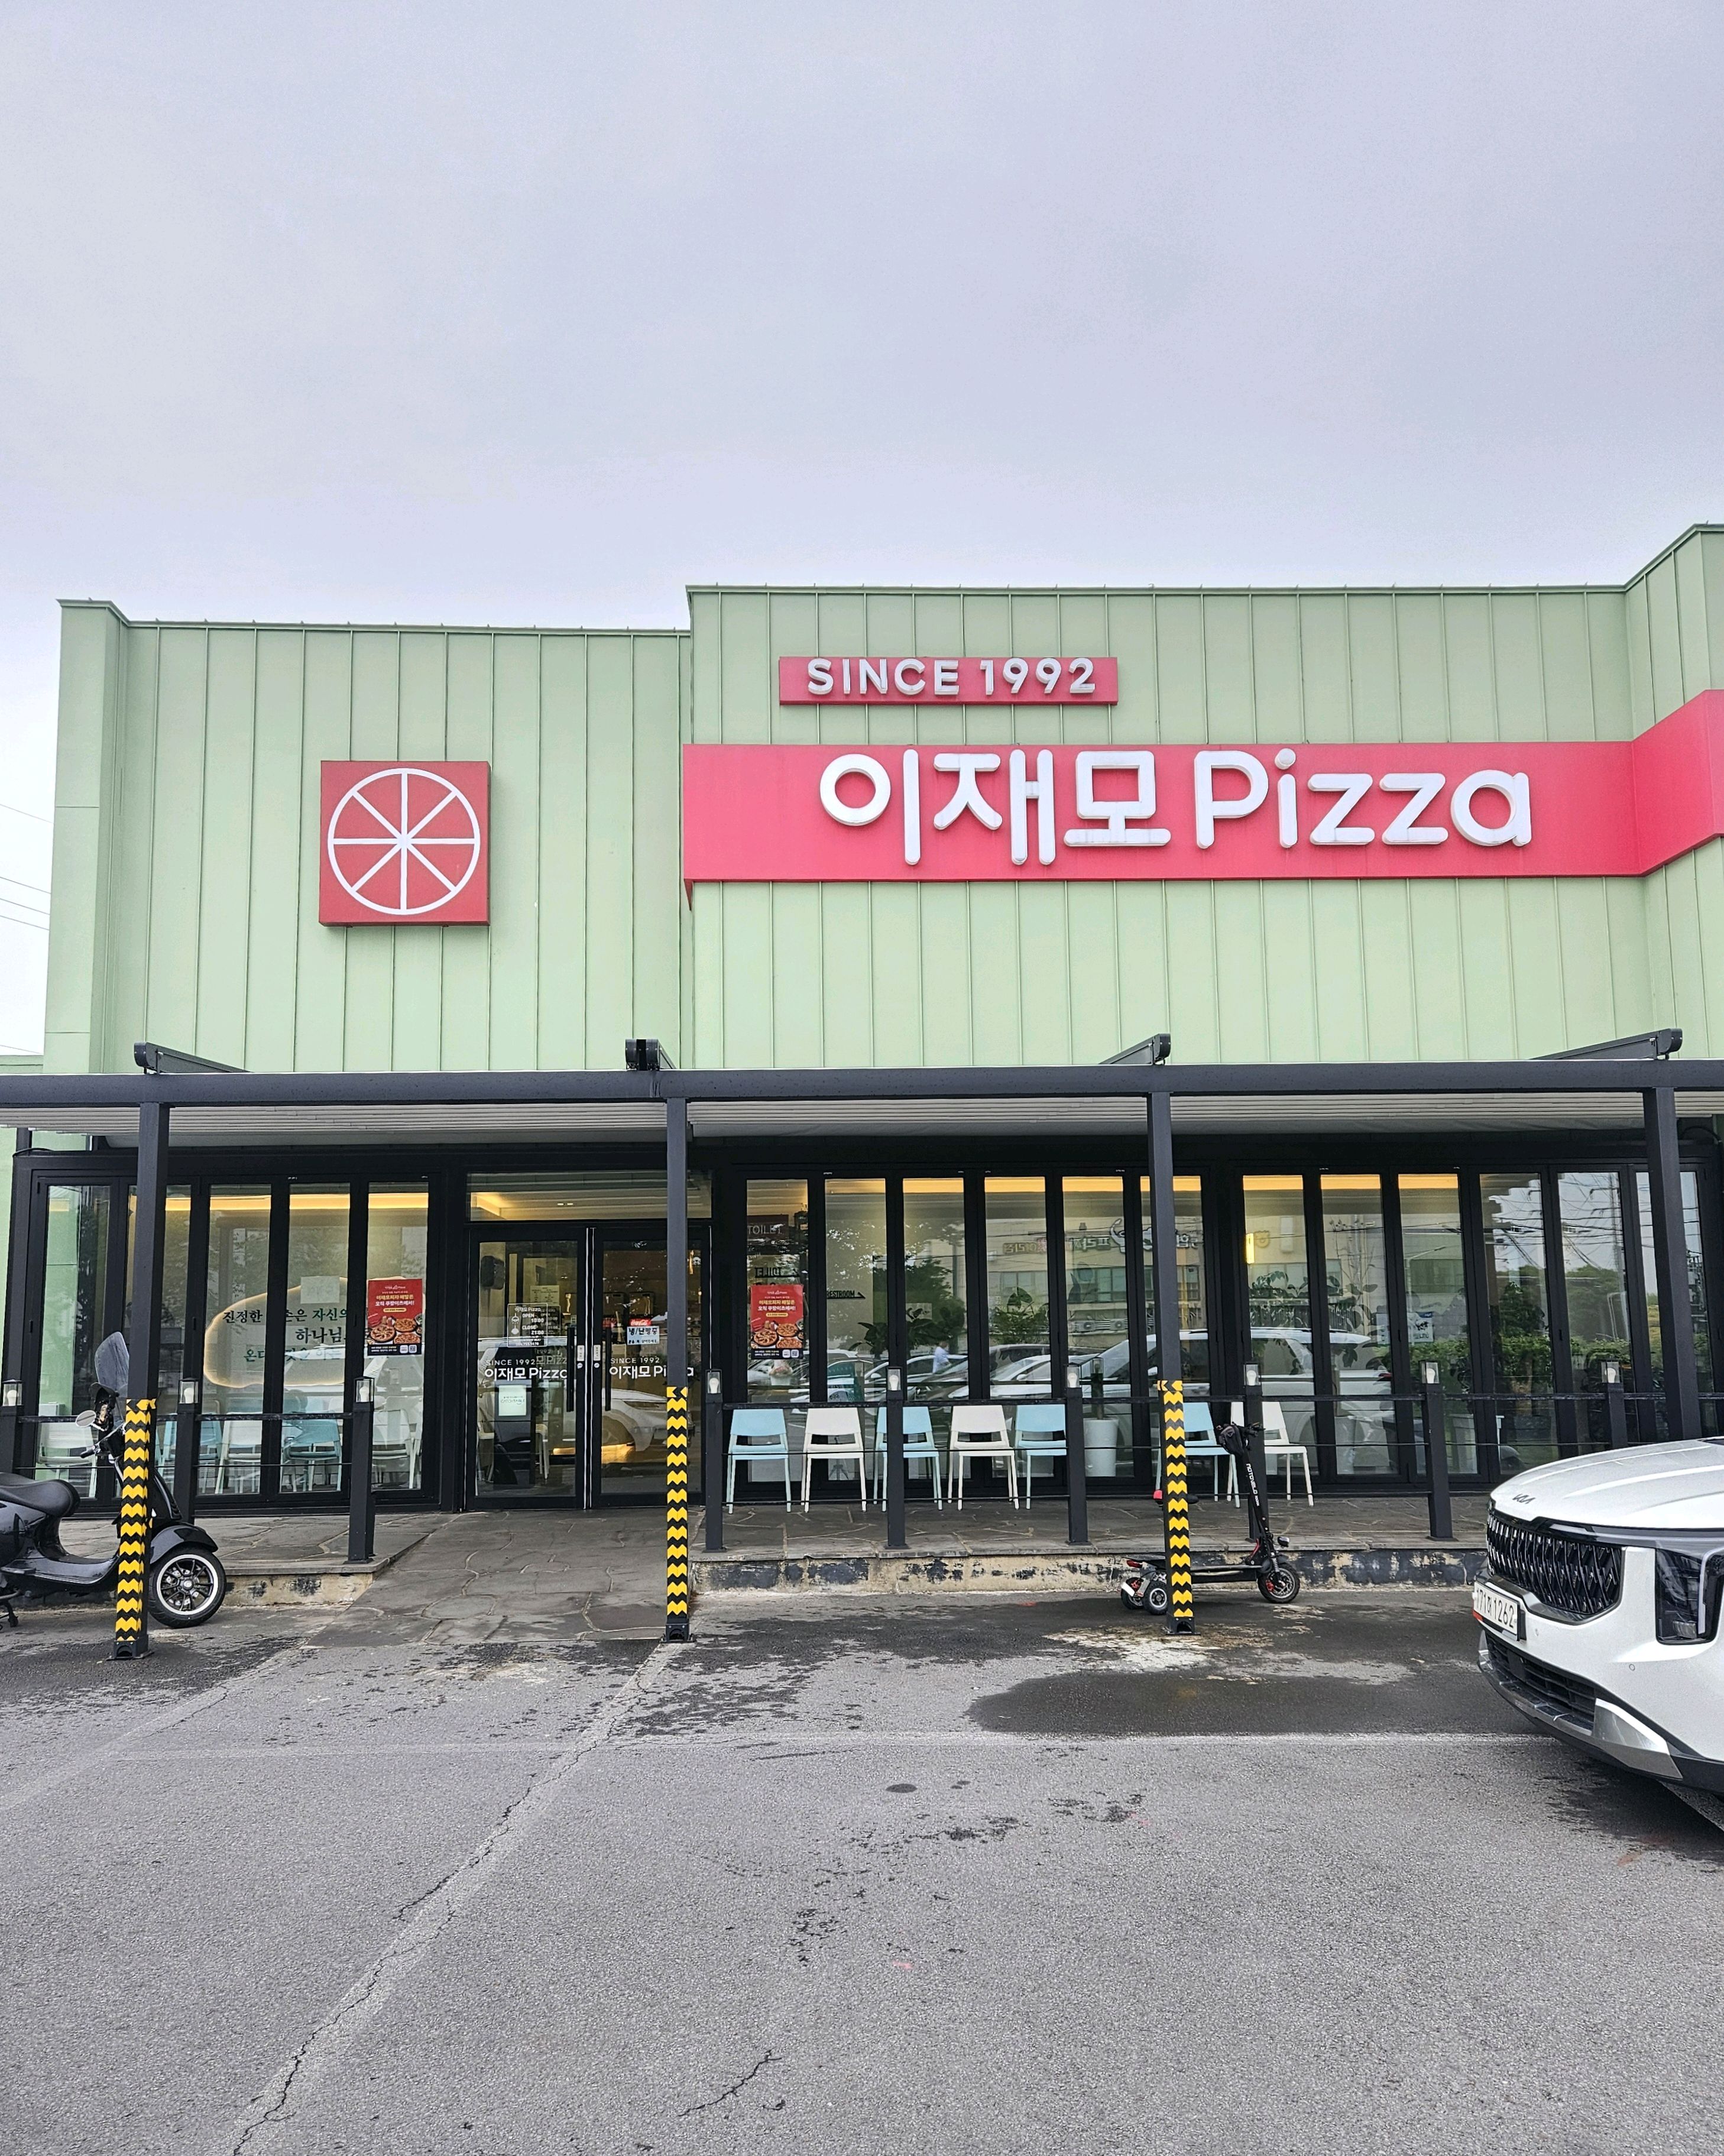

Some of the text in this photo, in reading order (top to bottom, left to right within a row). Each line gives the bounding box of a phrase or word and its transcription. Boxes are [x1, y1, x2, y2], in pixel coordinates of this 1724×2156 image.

[808, 658, 1096, 695] SINCE 1992
[819, 748, 1532, 865] 이재모 Pizza
[223, 1309, 263, 1323] 진정한
[484, 1367, 527, 1381] 이재모
[609, 1365, 694, 1379] 이재모 Pia
